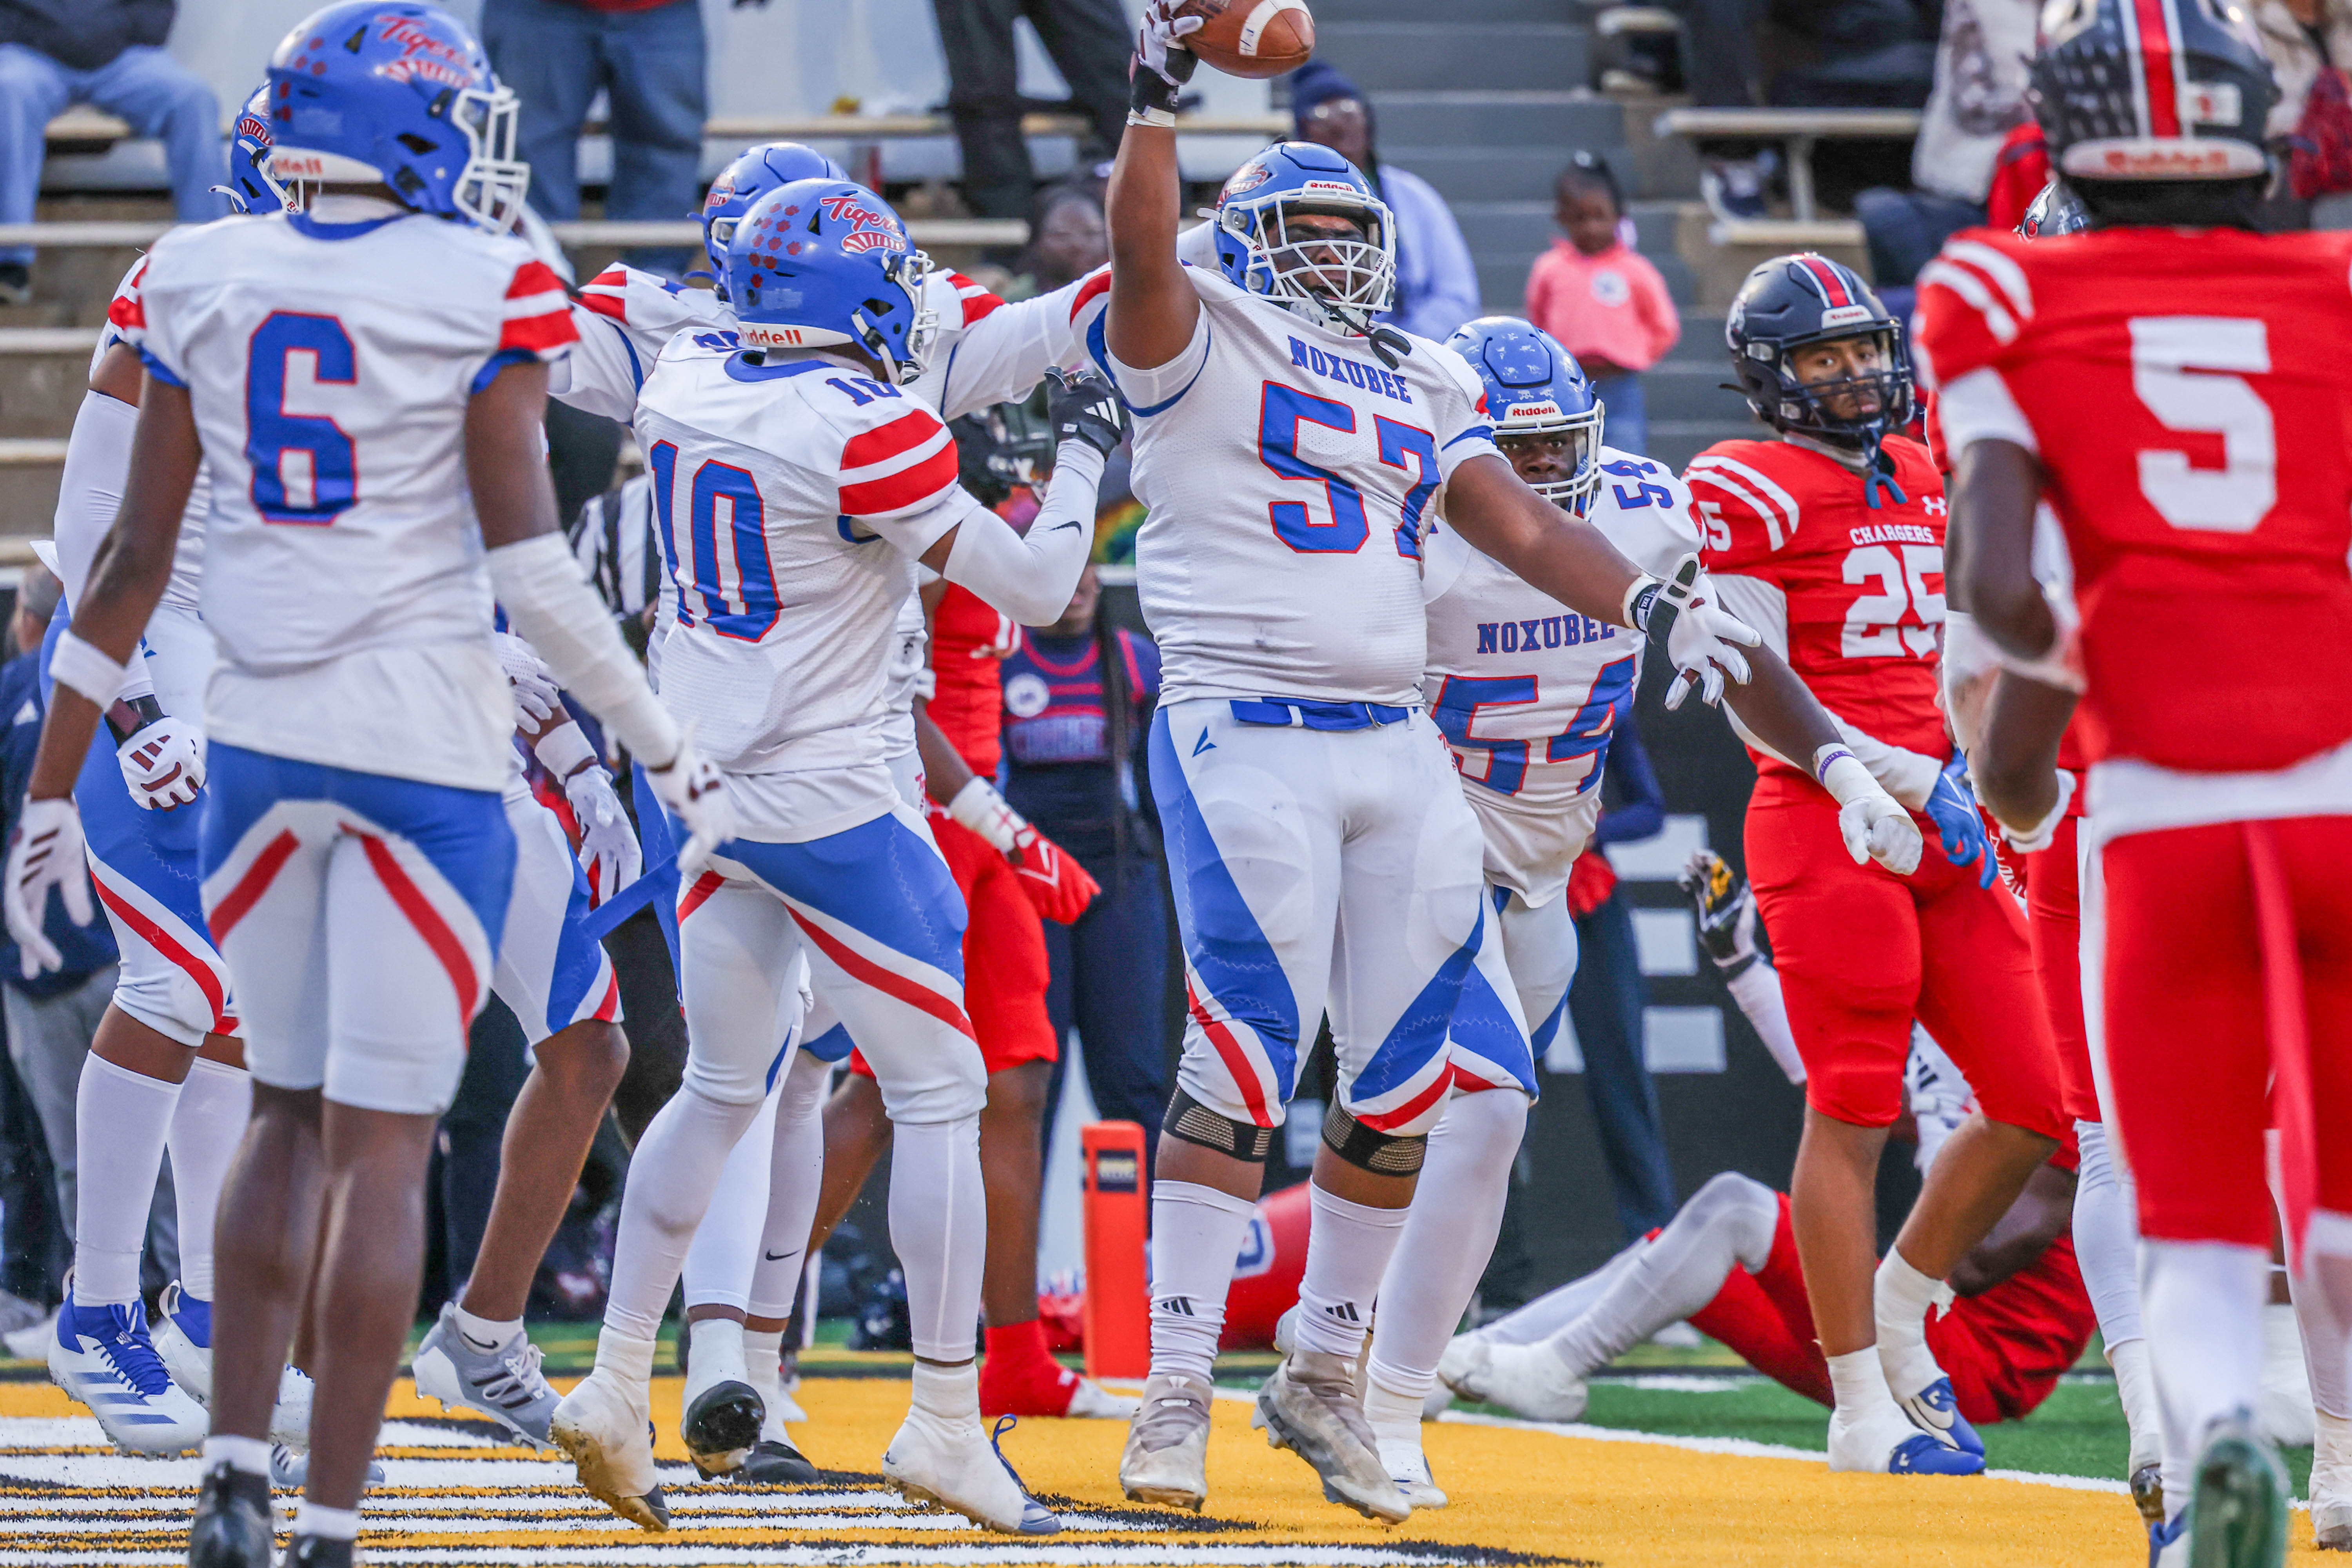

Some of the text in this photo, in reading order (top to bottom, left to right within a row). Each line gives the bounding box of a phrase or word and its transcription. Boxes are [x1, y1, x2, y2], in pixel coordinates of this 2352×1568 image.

[820, 197, 904, 236] Tigers
[825, 378, 903, 407] 10
[1287, 334, 1413, 405] NOXUBEE
[243, 309, 359, 526] 6
[1512, 406, 1555, 416] Riddell
[2127, 316, 2278, 534] 5
[1258, 379, 1442, 561] 57
[1600, 460, 1674, 510] 54
[650, 439, 783, 643] 10
[1698, 501, 1731, 552] 5
[1849, 524, 1935, 545] CHARGERS
[1841, 544, 1948, 659] 25
[1431, 654, 1635, 796] 54
